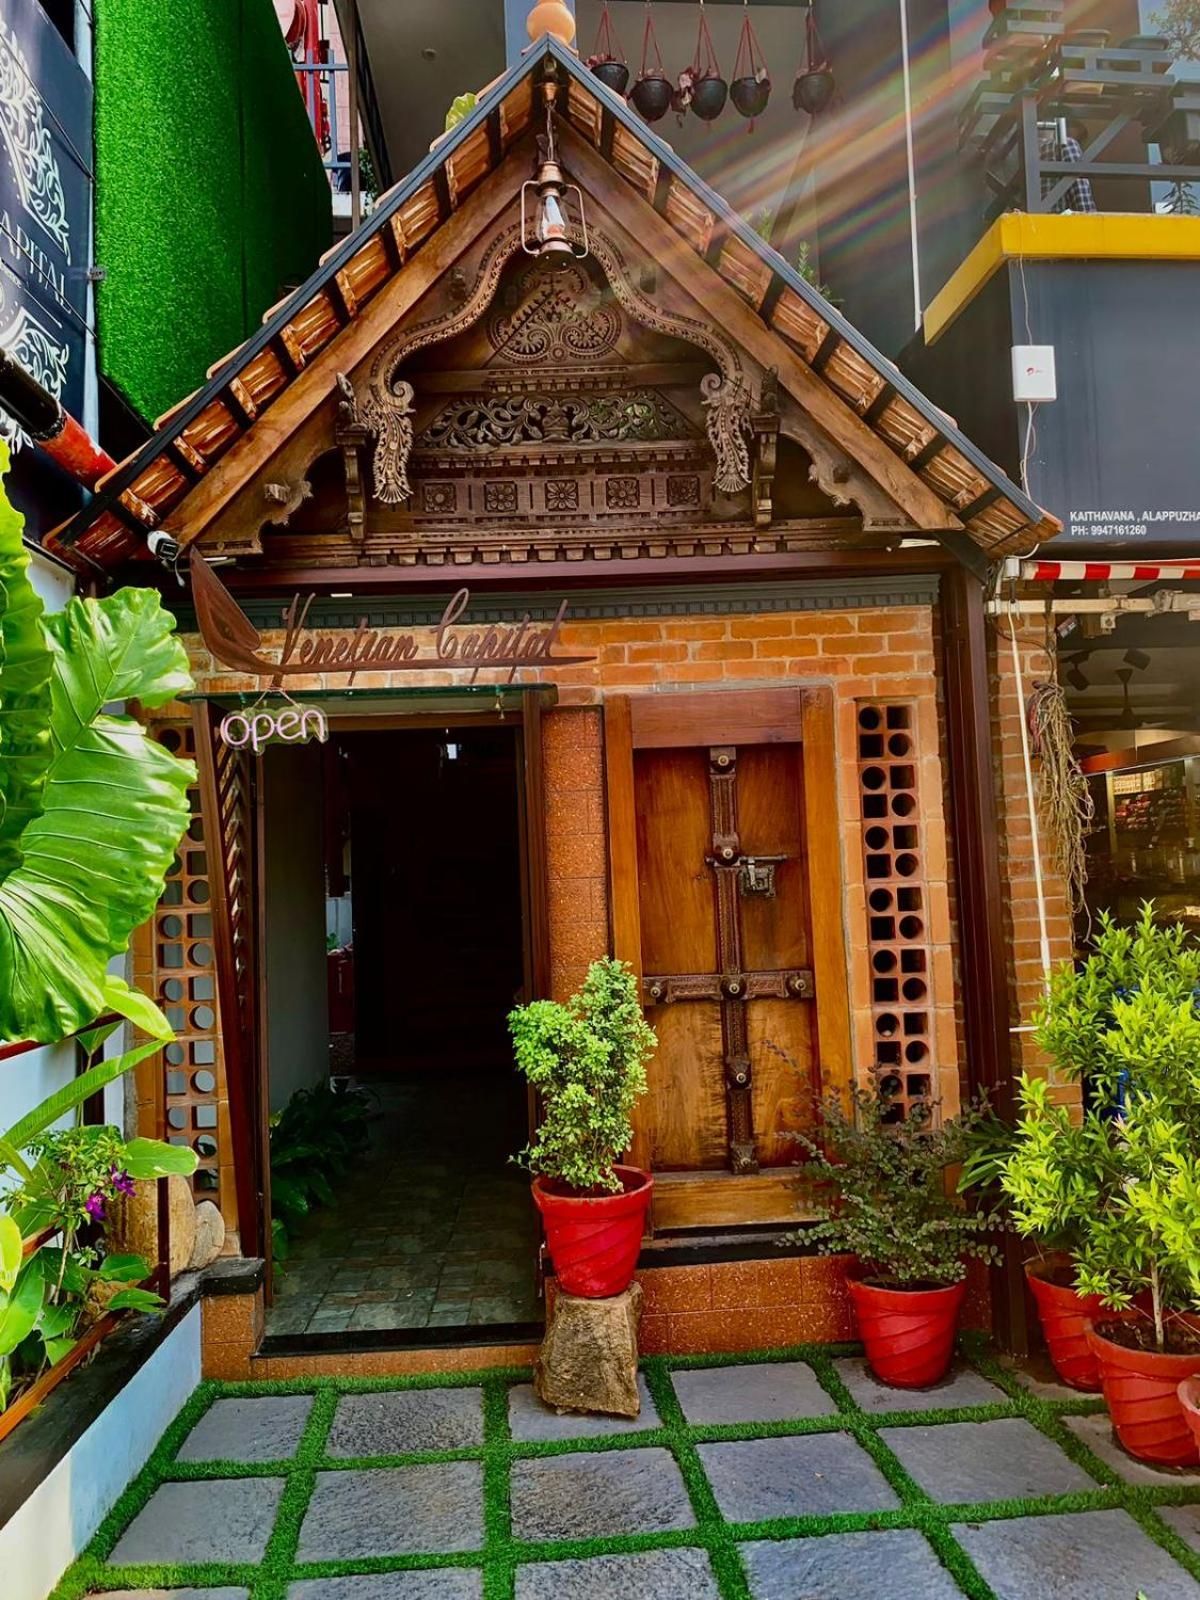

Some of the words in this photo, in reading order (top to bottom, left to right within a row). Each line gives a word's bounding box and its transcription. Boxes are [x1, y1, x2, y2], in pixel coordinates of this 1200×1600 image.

[1071, 526, 1089, 535] PH:
[1091, 525, 1147, 535] 9947161260
[281, 592, 419, 684] Venetian
[430, 588, 568, 684] Capital
[220, 710, 325, 752] open
